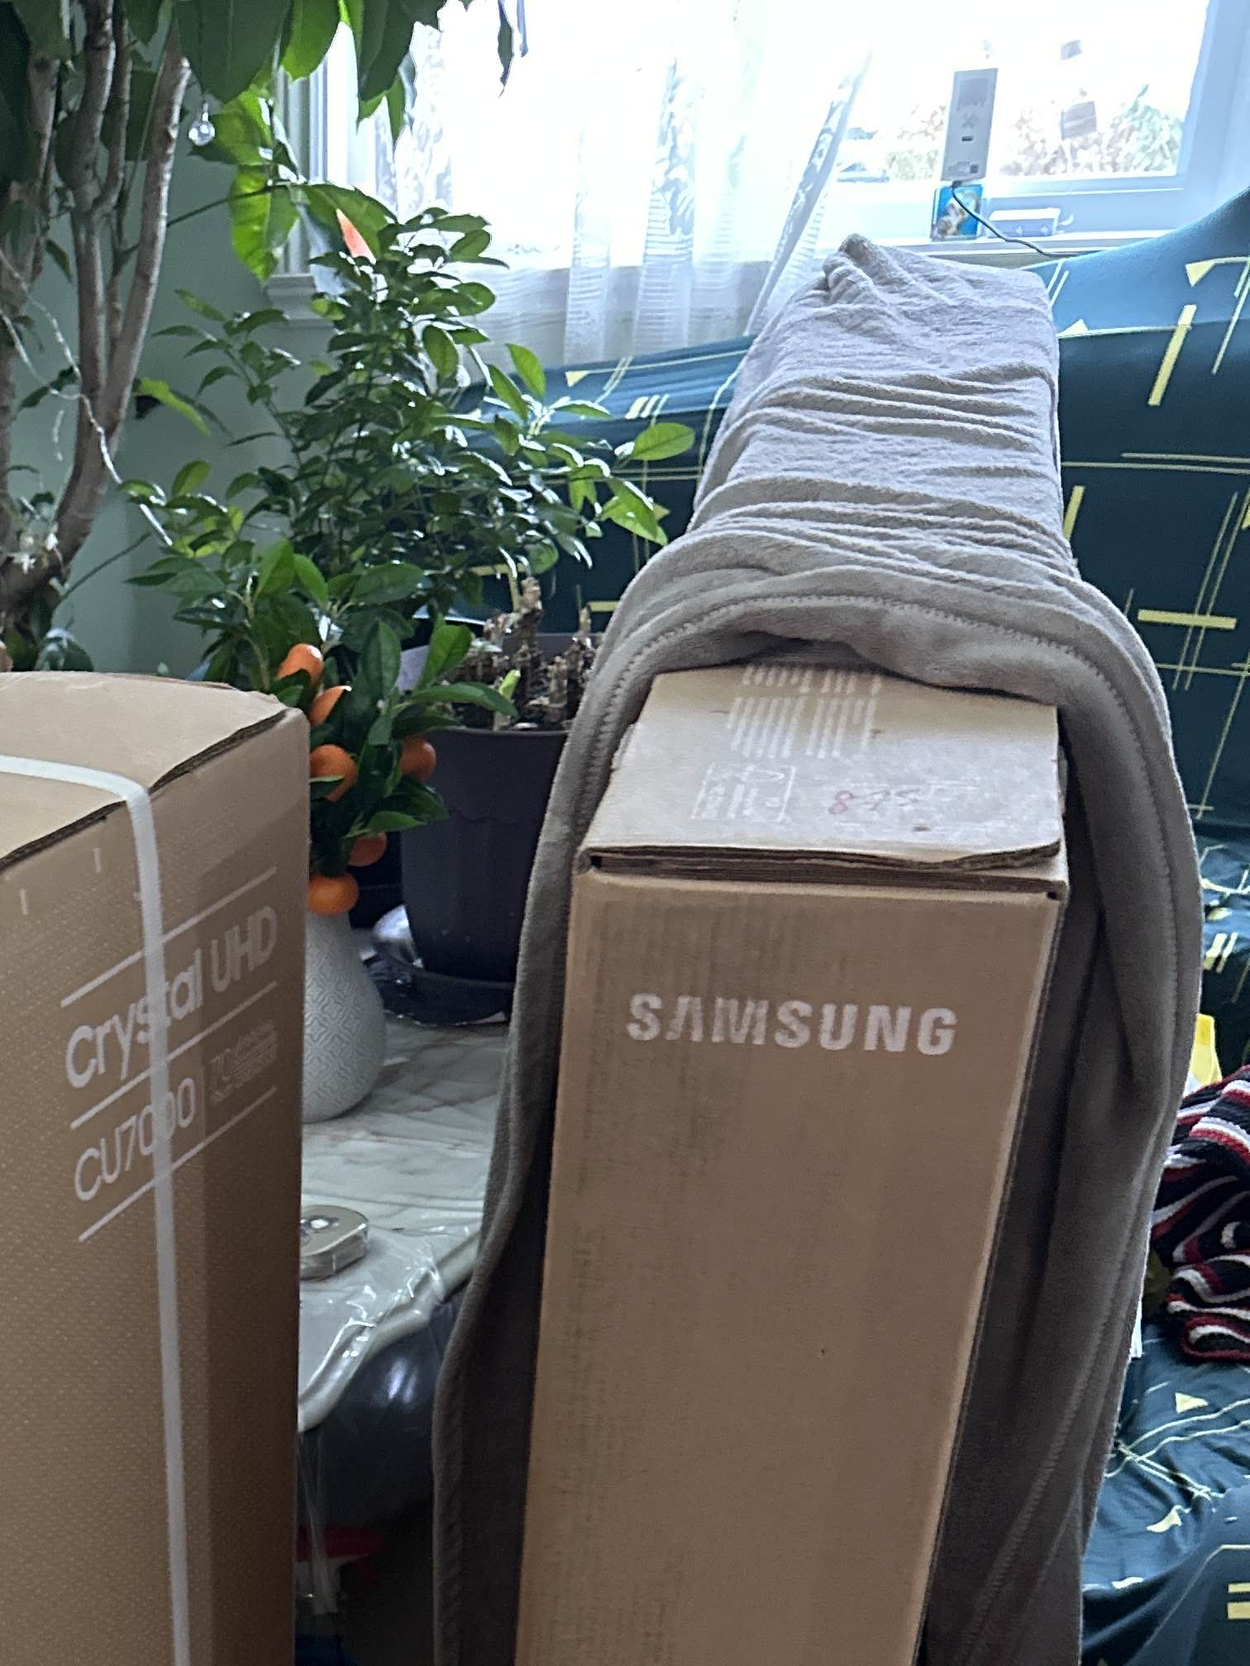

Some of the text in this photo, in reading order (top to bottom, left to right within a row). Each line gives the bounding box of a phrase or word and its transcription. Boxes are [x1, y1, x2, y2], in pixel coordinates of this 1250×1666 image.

[66, 948, 204, 1089] Crysal
[211, 905, 278, 992] UHD
[626, 992, 958, 1056] SAMSUNG
